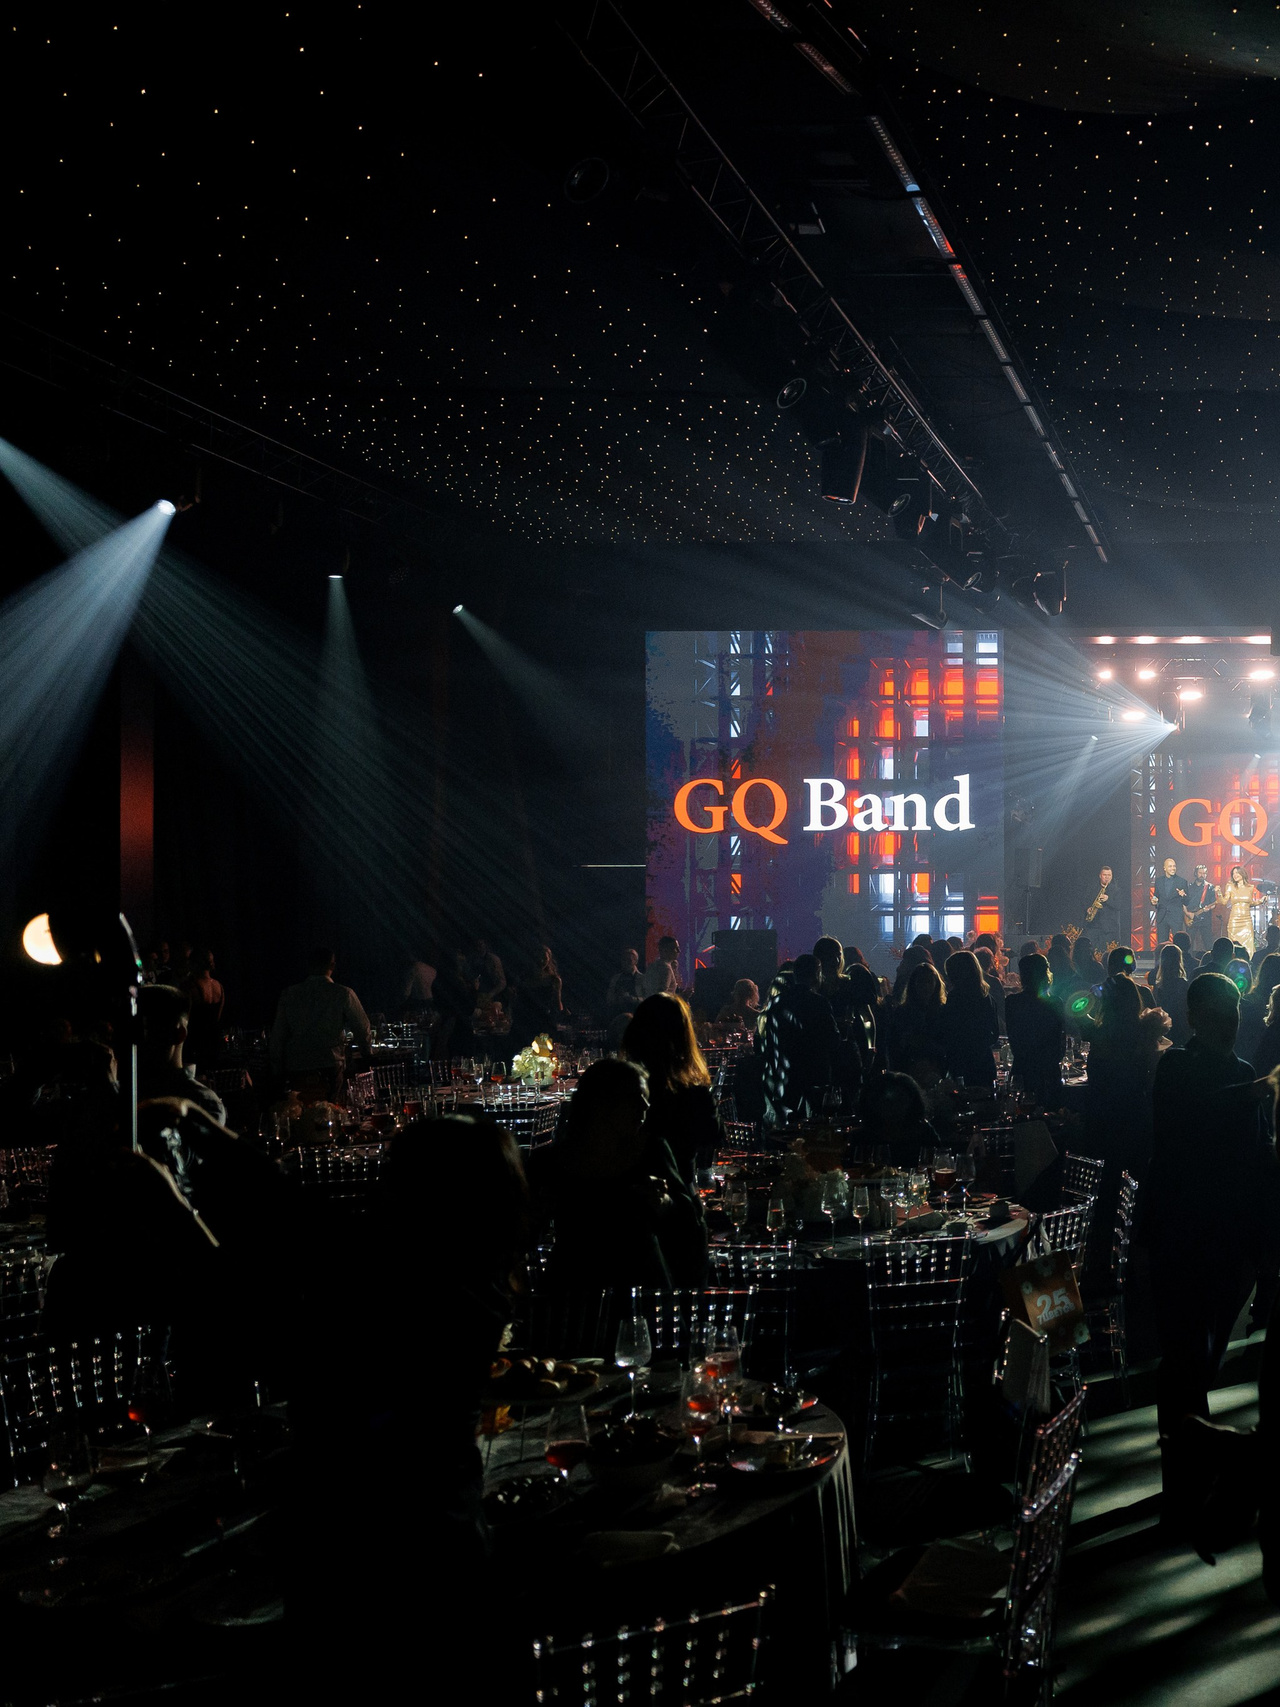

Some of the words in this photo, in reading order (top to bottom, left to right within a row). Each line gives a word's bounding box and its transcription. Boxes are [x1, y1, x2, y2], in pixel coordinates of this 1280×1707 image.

[673, 778, 789, 845] GQ
[803, 773, 976, 832] Band
[1168, 798, 1269, 857] GQ
[1036, 1287, 1071, 1314] 25
